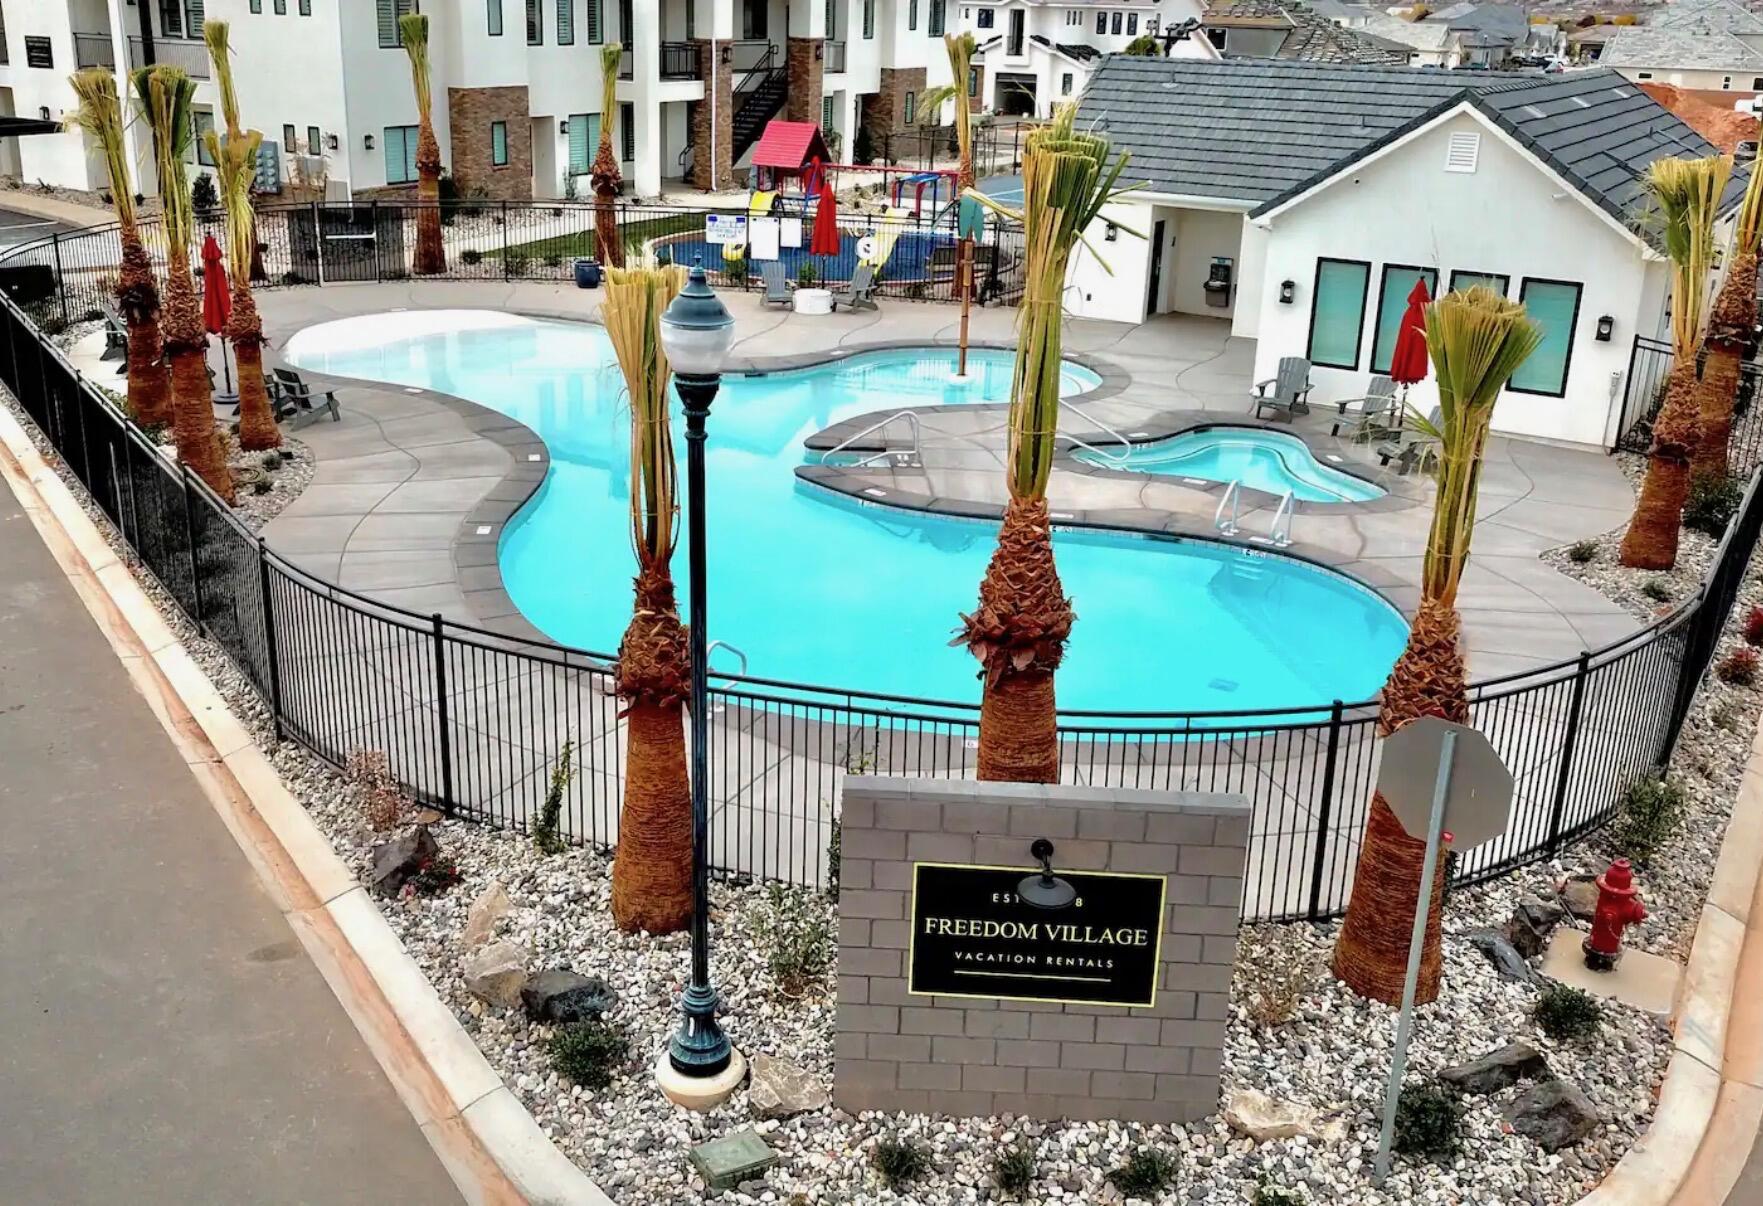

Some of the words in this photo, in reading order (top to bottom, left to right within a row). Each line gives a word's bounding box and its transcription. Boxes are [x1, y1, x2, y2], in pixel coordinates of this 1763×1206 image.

[925, 917, 1038, 940] FREEDOM
[1044, 924, 1148, 946] VILLAGE
[954, 951, 1036, 964] VACATION
[1046, 956, 1113, 969] RENTALS
